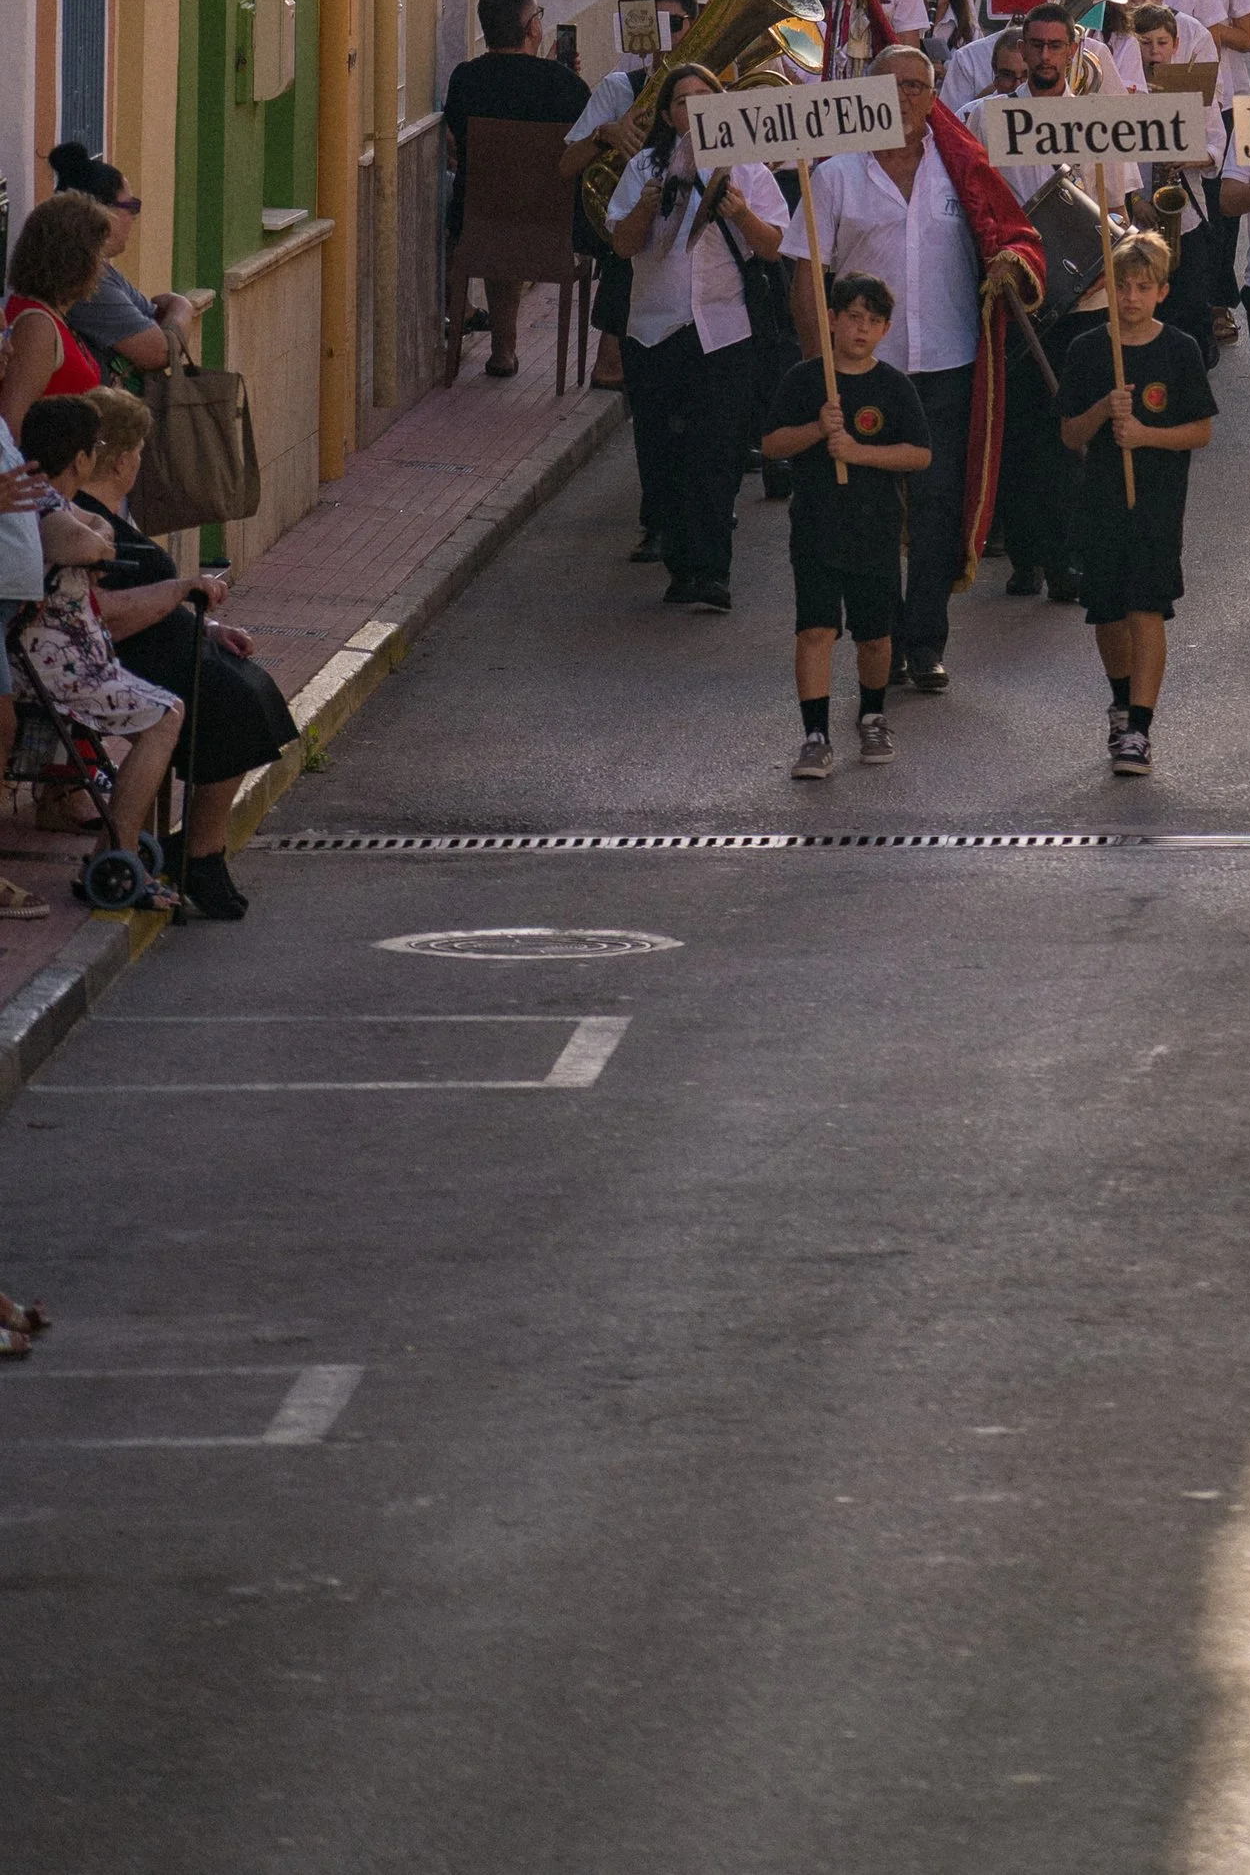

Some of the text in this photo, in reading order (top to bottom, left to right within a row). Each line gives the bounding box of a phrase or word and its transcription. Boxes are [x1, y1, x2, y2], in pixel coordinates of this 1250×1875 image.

[693, 94, 893, 151] La Vall d'Ebo
[1002, 109, 1189, 155] Parcent
